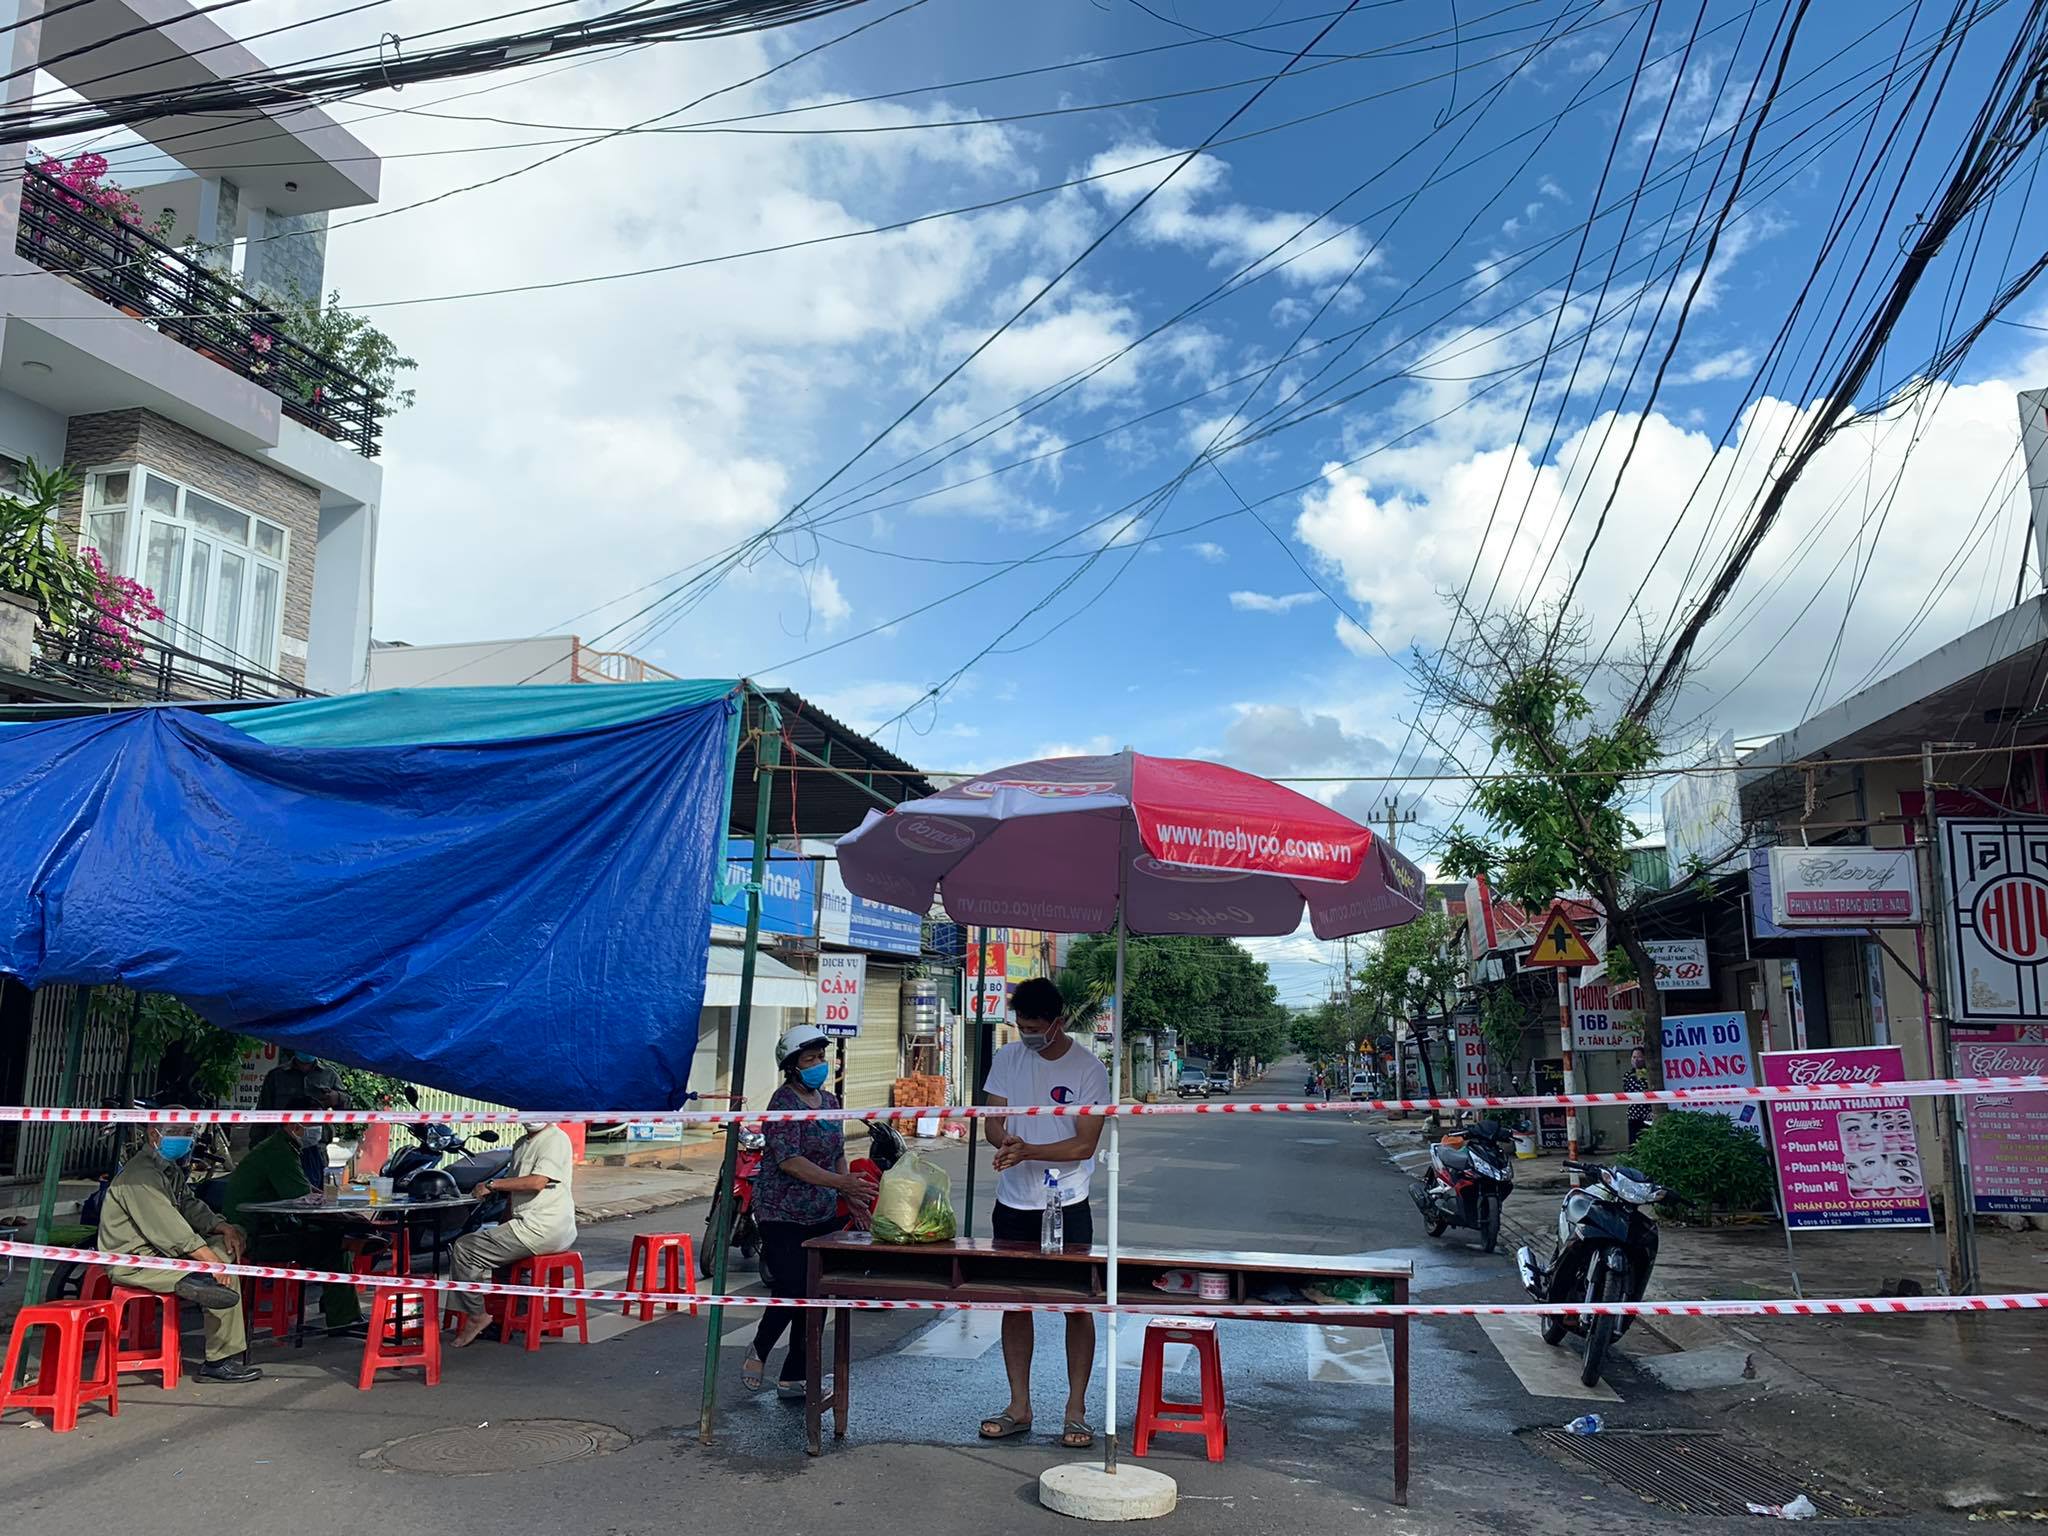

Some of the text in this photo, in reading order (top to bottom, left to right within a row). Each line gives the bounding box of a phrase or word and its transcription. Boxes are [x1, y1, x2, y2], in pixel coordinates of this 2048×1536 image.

[727, 863, 801, 901] vinahone
[1798, 857, 1895, 891] Cherry
[821, 971, 857, 994] CẦM
[826, 998, 849, 1020] ĐỒ
[1578, 1014, 1608, 1031] 16B
[1661, 1017, 1741, 1048] CẦM ĐỒ
[1664, 1051, 1746, 1079] HOÀNG
[1788, 1058, 1881, 1085] Cherry
[1969, 1047, 2046, 1076] Cherry
[1775, 1102, 1809, 1112] PHUN
[1788, 1140, 1839, 1152] Phun Môi
[1791, 1161, 1845, 1174] Phun Mày
[1794, 1182, 1823, 1193] Phun
